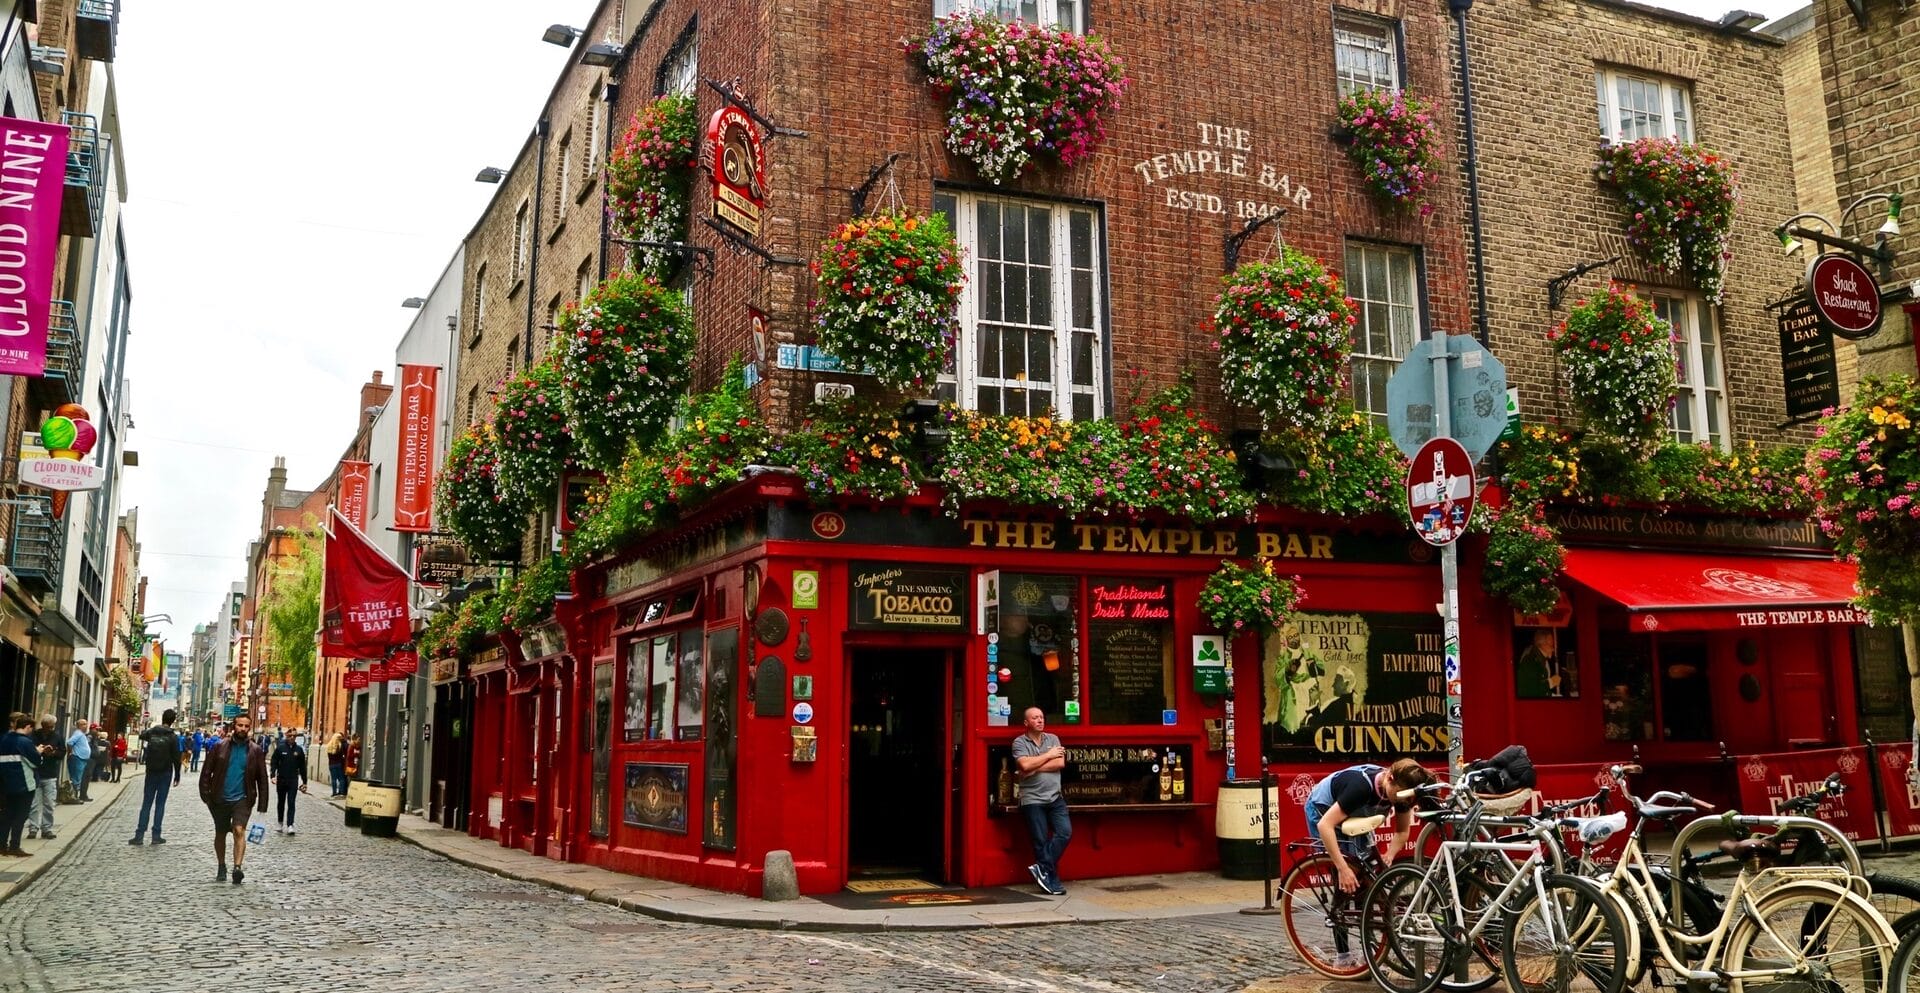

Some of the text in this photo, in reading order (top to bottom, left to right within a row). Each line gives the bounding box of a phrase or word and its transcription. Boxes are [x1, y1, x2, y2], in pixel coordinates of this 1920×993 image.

[1197, 122, 1252, 151] THE
[718, 120, 727, 146] THE
[753, 143, 762, 173] BAR
[0, 130, 52, 211] NINE
[1134, 150, 1312, 210] TEMPLE BAR
[1165, 187, 1227, 215] ESTD.
[0, 223, 30, 338] CLOUD
[1832, 269, 1858, 295] Shack
[1796, 305, 1811, 316] THE
[1823, 291, 1872, 313] Restaurant
[1782, 314, 1819, 331] TEMPL
[1793, 328, 1819, 342] BAR
[10, 350, 29, 360] NINE
[1808, 383, 1832, 393] MUSIC
[403, 394, 419, 505] THE TEMPLE BAR
[418, 413, 429, 485] TRADING CO.
[34, 461, 93, 478] CLOUD NINE
[41, 477, 83, 486] GELATERIA
[353, 482, 363, 502] THE
[818, 515, 838, 533] 48
[964, 519, 1334, 559] THE TEMPLE BAR
[854, 568, 902, 588] Importers
[897, 585, 952, 594] FINE SMOKING
[1093, 585, 1166, 602] Traditional
[363, 601, 387, 610] THE
[867, 588, 953, 619] TOBACCO
[1092, 602, 1170, 619] Irish Music
[348, 606, 403, 622] TEMPLE
[885, 614, 960, 625] Always in Stock
[1737, 612, 1767, 626] THE
[1769, 611, 1825, 625] TEMPLE
[1826, 609, 1856, 623] BAR
[362, 620, 391, 632] BAR
[1297, 620, 1368, 636] TEMPLE
[1319, 636, 1351, 652] BAR
[1415, 634, 1441, 652] THE
[1383, 654, 1442, 673] EMPEROR
[1428, 676, 1443, 693] OF
[1346, 702, 1396, 723] MALTED
[1314, 725, 1449, 753] GUINNESS
[1065, 749, 1123, 762] TEMPLE
[1079, 764, 1109, 772] DUBLIN
[1064, 786, 1079, 794] LIVE
[1767, 785, 1783, 795] THE
